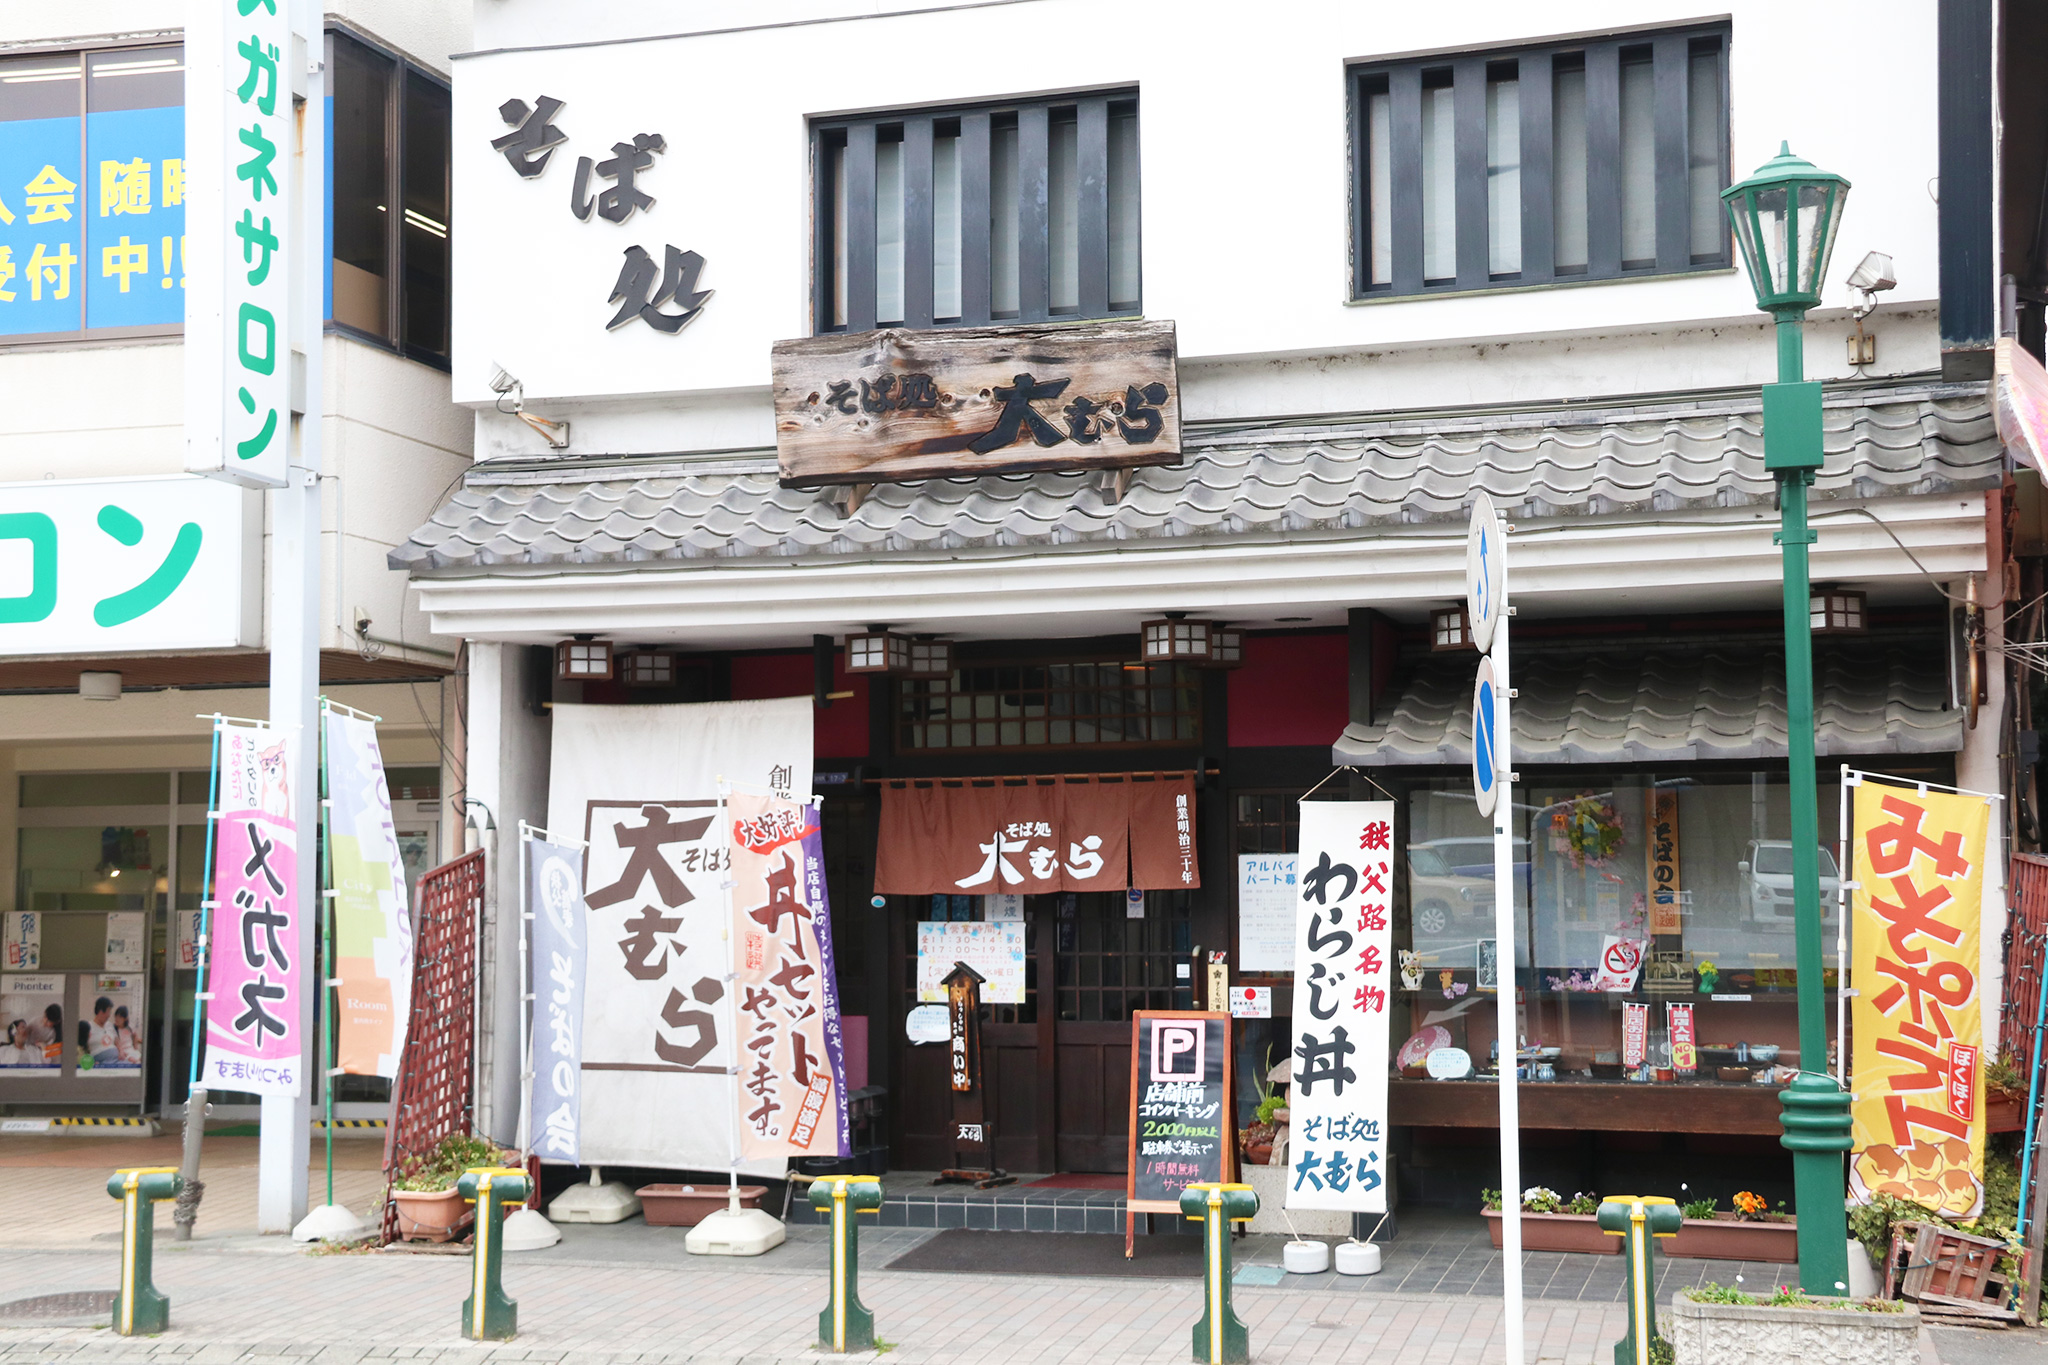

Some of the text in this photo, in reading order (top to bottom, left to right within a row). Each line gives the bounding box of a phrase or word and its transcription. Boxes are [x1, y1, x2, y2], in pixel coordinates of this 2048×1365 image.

[236, 0, 280, 460] ガネサロン
[490, 95, 716, 336] そば処
[825, 373, 939, 415] そば処
[968, 371, 1170, 456] 大むら
[742, 804, 806, 846] 大好評!
[1005, 821, 1052, 838] そば処
[1175, 793, 1193, 885] 創業明治三十年
[954, 830, 1105, 889] 大むら
[584, 804, 726, 1068] 大むら
[1353, 821, 1391, 1013] 秩父路名物
[1294, 851, 1357, 1097] わらじ丼
[1866, 793, 1974, 1149] みそポテト
[346, 997, 388, 1012] Room
[740, 986, 781, 1136] やってます。
[952, 1035, 966, 1089] 商い中
[1163, 1028, 1195, 1073] P
[1138, 1101, 1220, 1119] コインパーキング
[1144, 1081, 1207, 1105] 店舗前
[1952, 1048, 1972, 1116] ほくほく
[1303, 1112, 1379, 1142] そば処
[1293, 1150, 1382, 1193] 大むら
